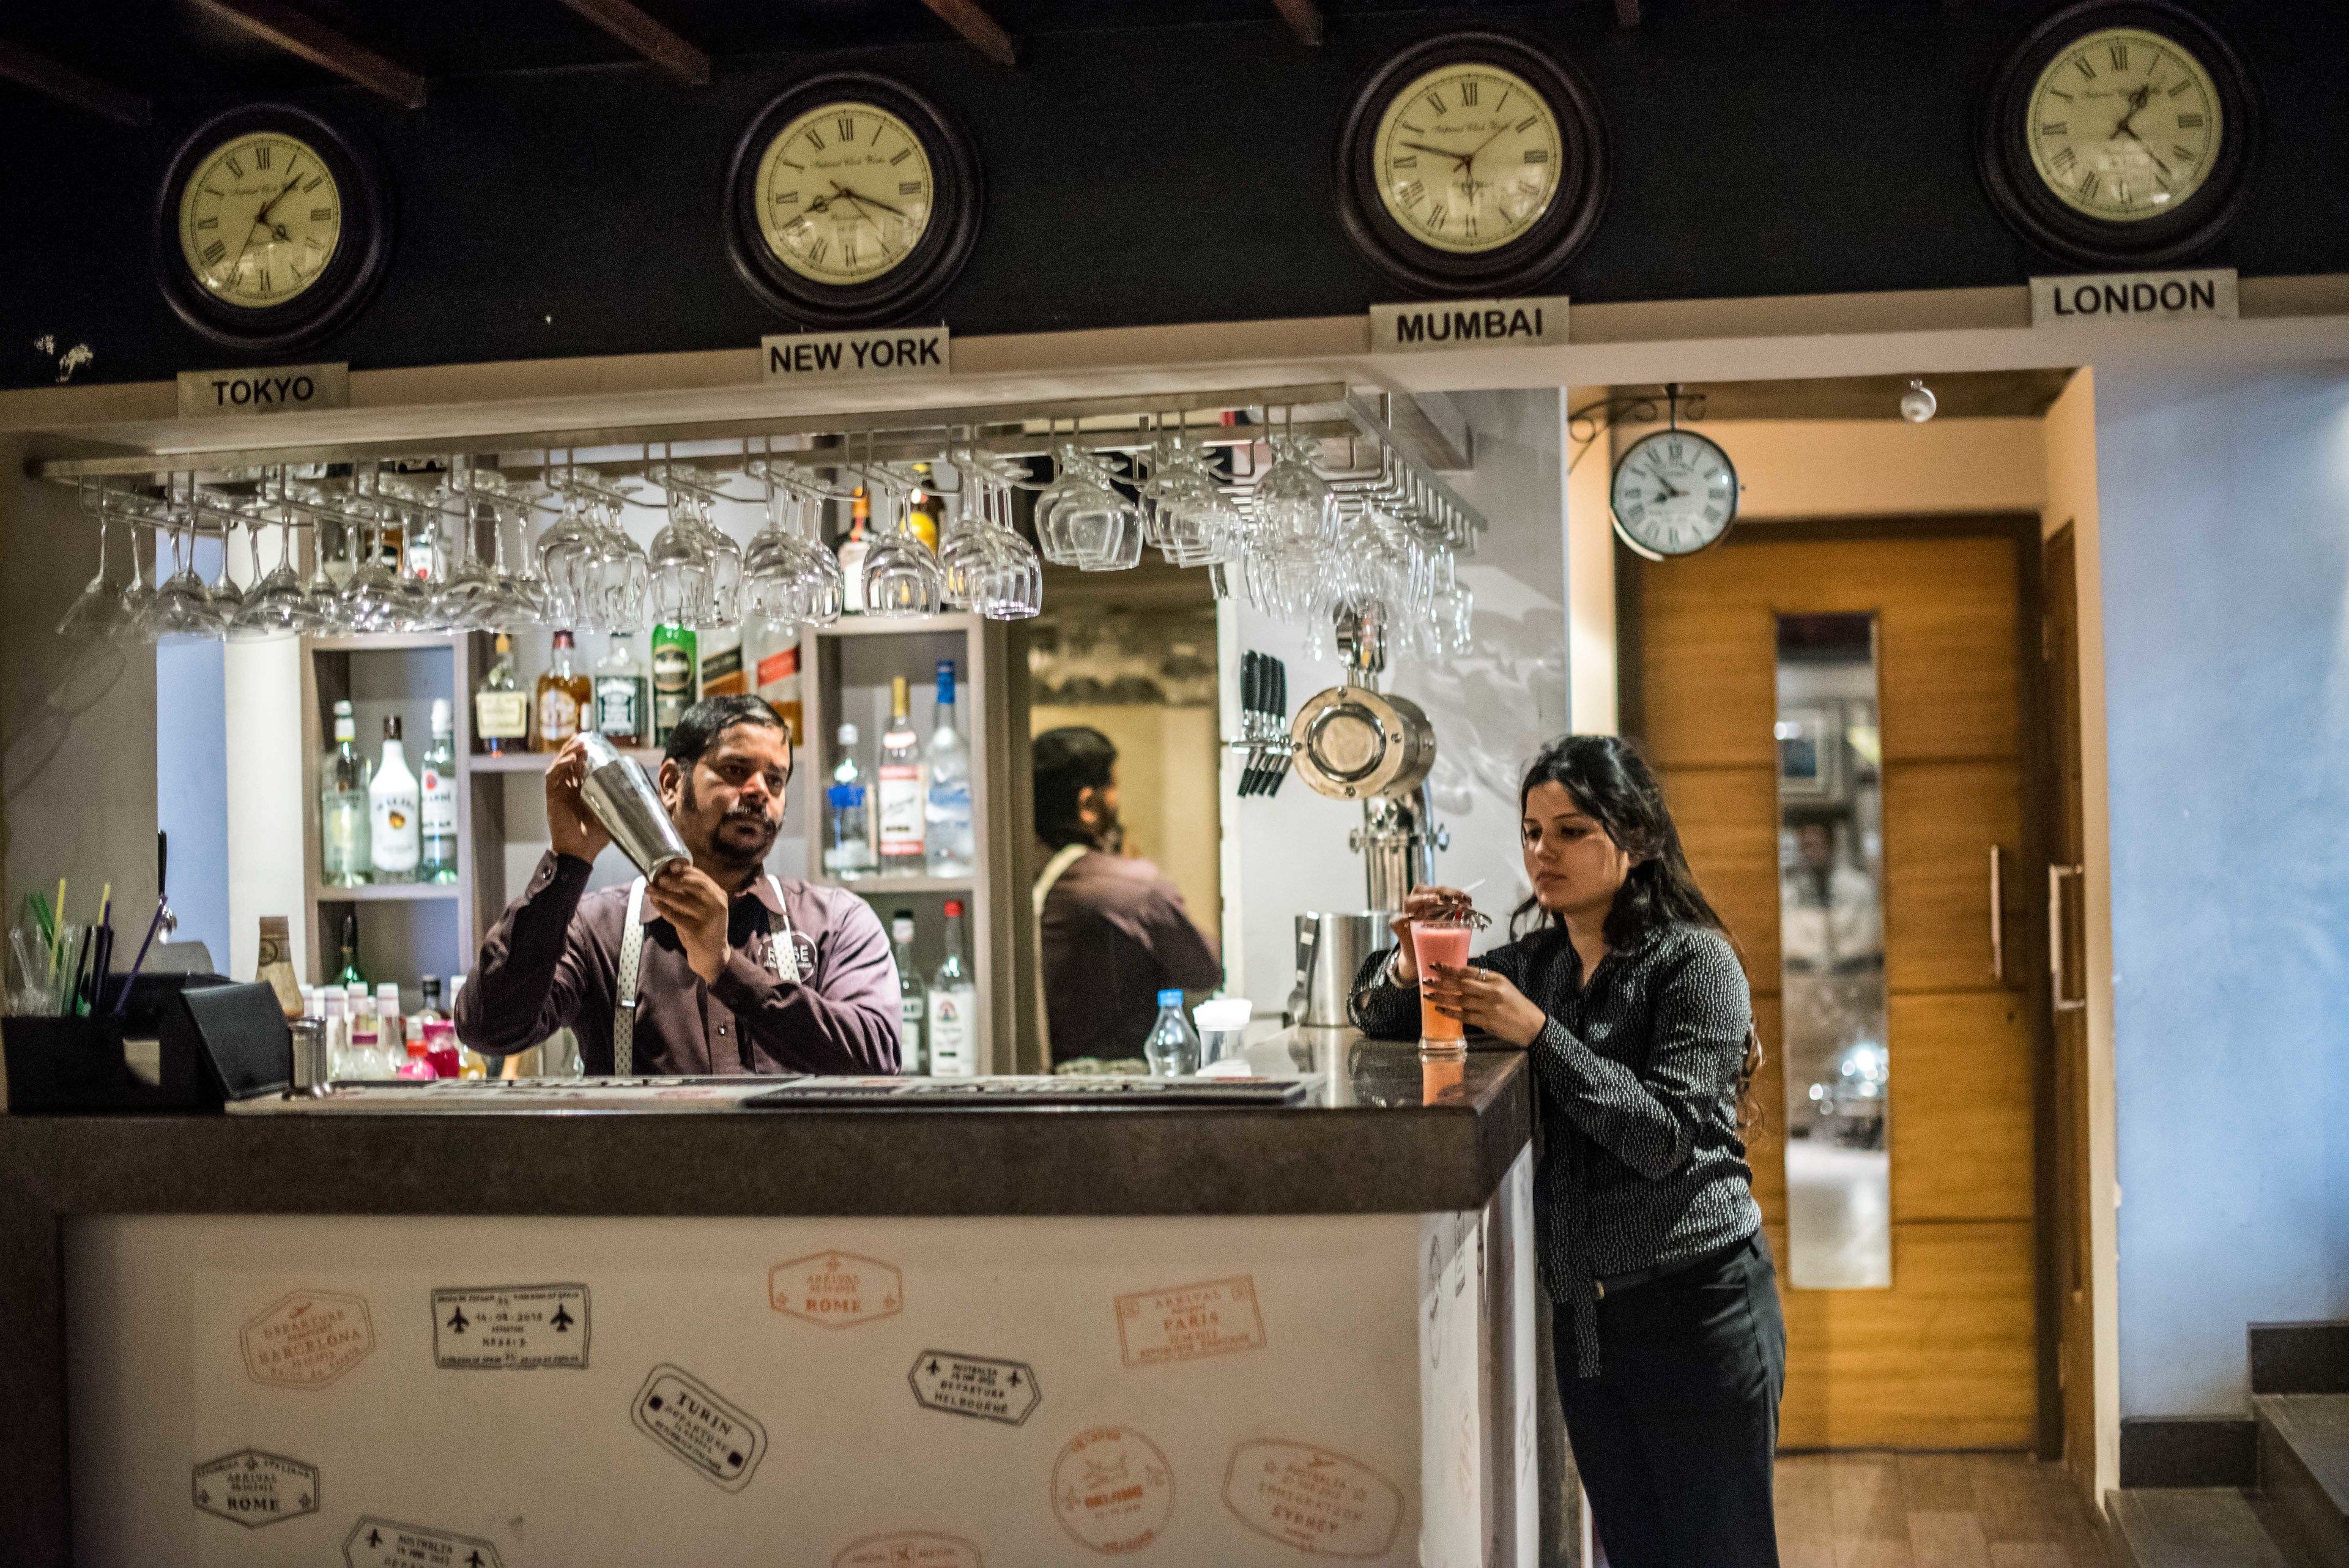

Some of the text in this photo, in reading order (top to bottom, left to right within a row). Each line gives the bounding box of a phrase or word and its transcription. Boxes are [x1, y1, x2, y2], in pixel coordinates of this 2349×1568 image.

[2110, 45, 2128, 71] XII
[1461, 82, 1477, 106] XII
[838, 118, 853, 141] XII
[256, 147, 269, 170] XII
[2054, 278, 2216, 316] LONDON
[1397, 307, 1543, 343] MUMBAI
[770, 336, 941, 374] NEW YORK
[212, 376, 314, 406] TOKYO
[806, 1298, 861, 1312] ROME
[1163, 1310, 1219, 1332] PARIS
[258, 1327, 362, 1365] BARCELONA
[678, 1391, 732, 1436] TURIN
[934, 1392, 1008, 1414] MELBOURNE
[226, 1496, 279, 1511] ROME
[1271, 1503, 1339, 1536] SYDNEY
